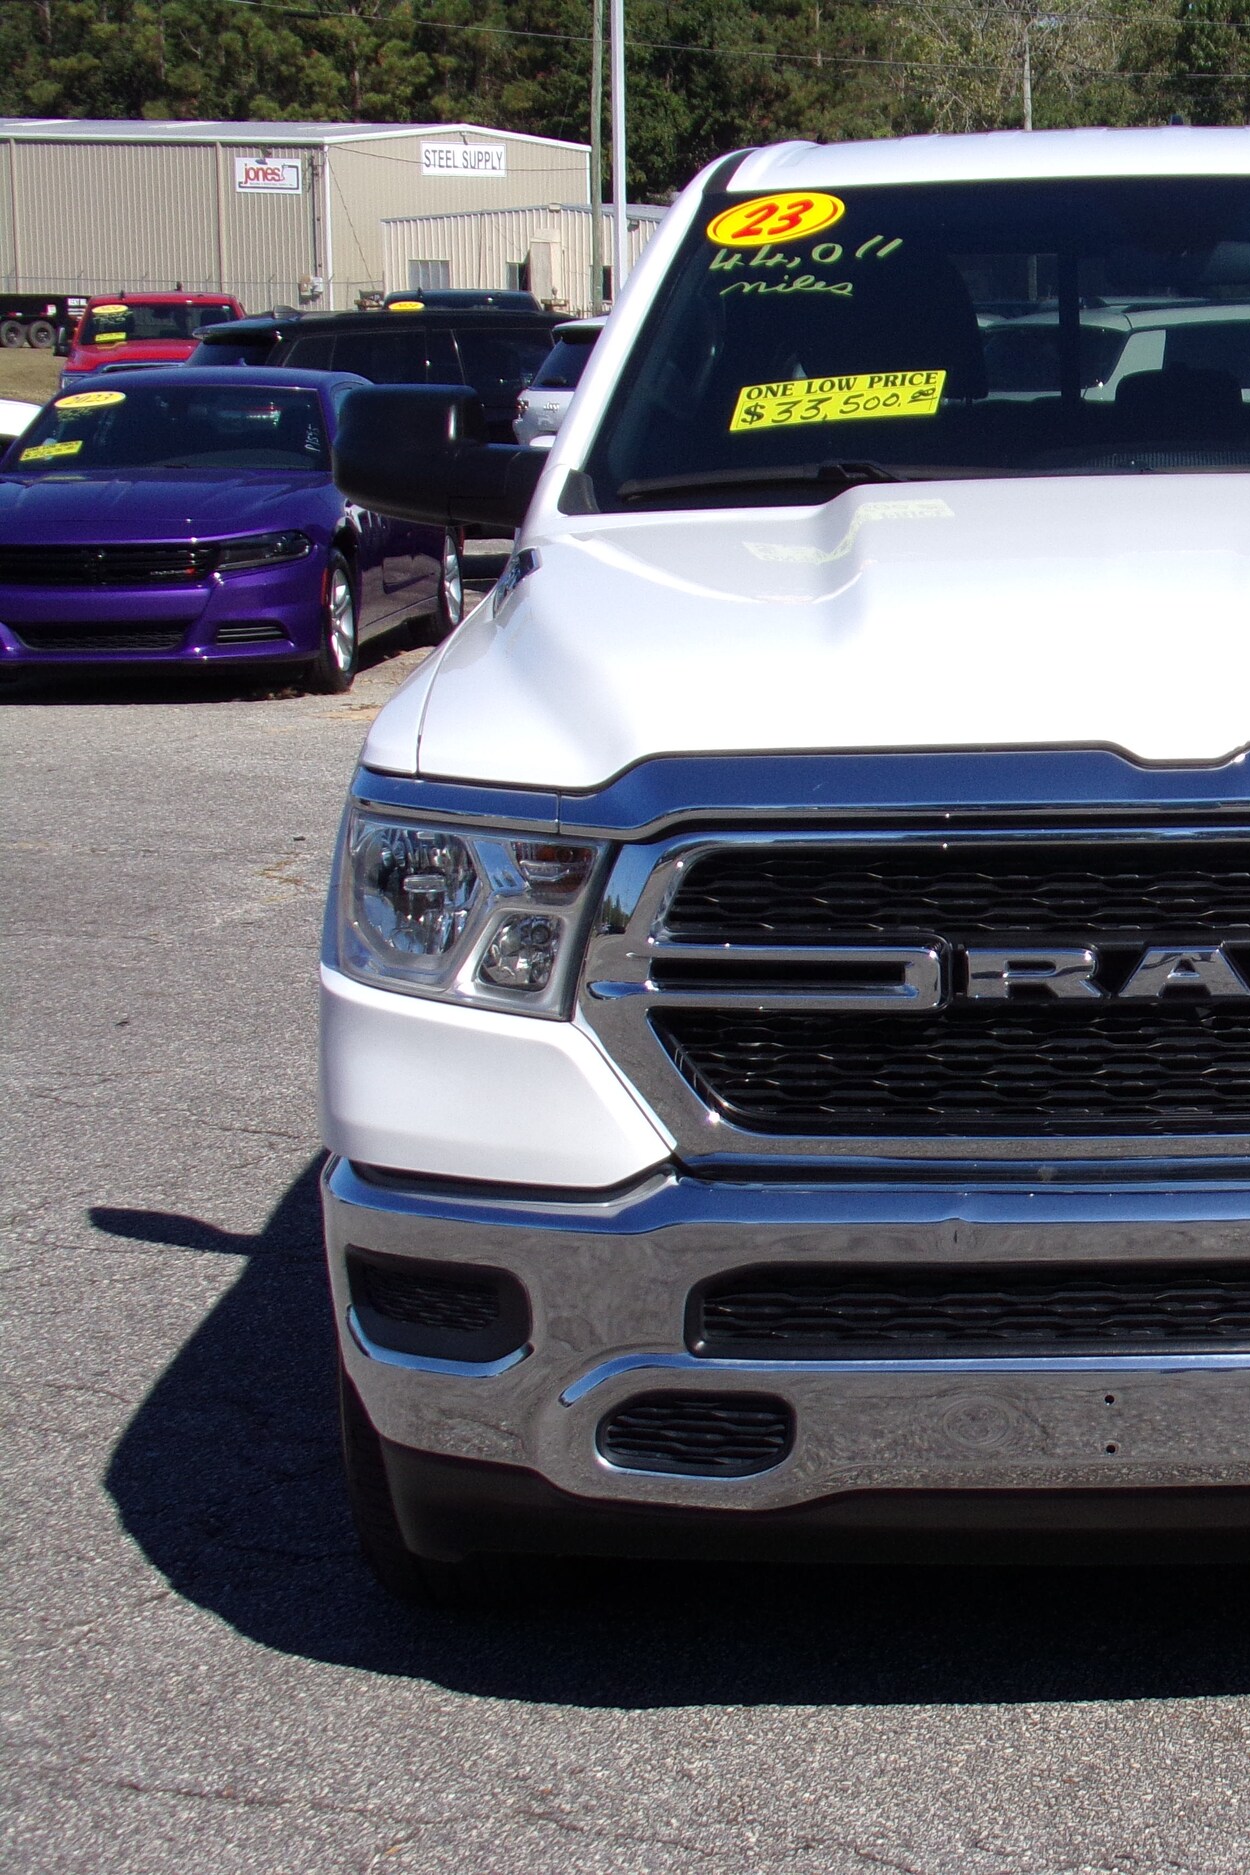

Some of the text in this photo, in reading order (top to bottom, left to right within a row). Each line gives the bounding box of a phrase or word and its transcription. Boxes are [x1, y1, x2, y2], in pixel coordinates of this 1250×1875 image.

[424, 148, 503, 170] STEEL SUPPLY
[243, 163, 282, 185] jones
[730, 198, 815, 240] 23
[719, 274, 854, 297] miles
[745, 371, 939, 401] ONE LOW PRICE
